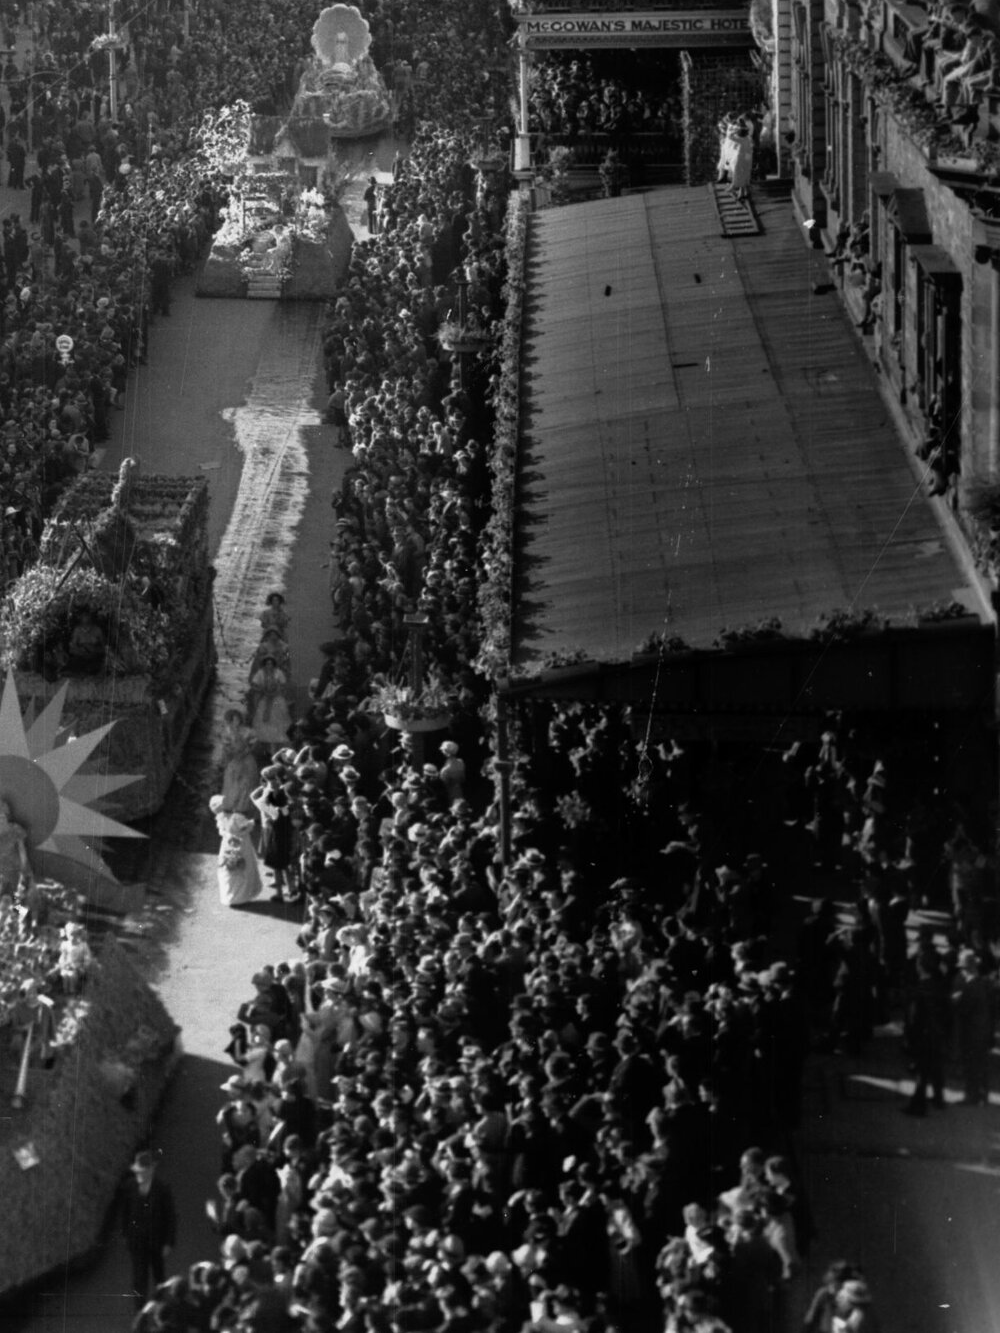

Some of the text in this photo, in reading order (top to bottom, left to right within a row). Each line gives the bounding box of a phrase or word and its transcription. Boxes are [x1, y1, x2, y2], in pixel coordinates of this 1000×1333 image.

[526, 18, 749, 33] McGOWAN'S MAJESTIC HOTE
